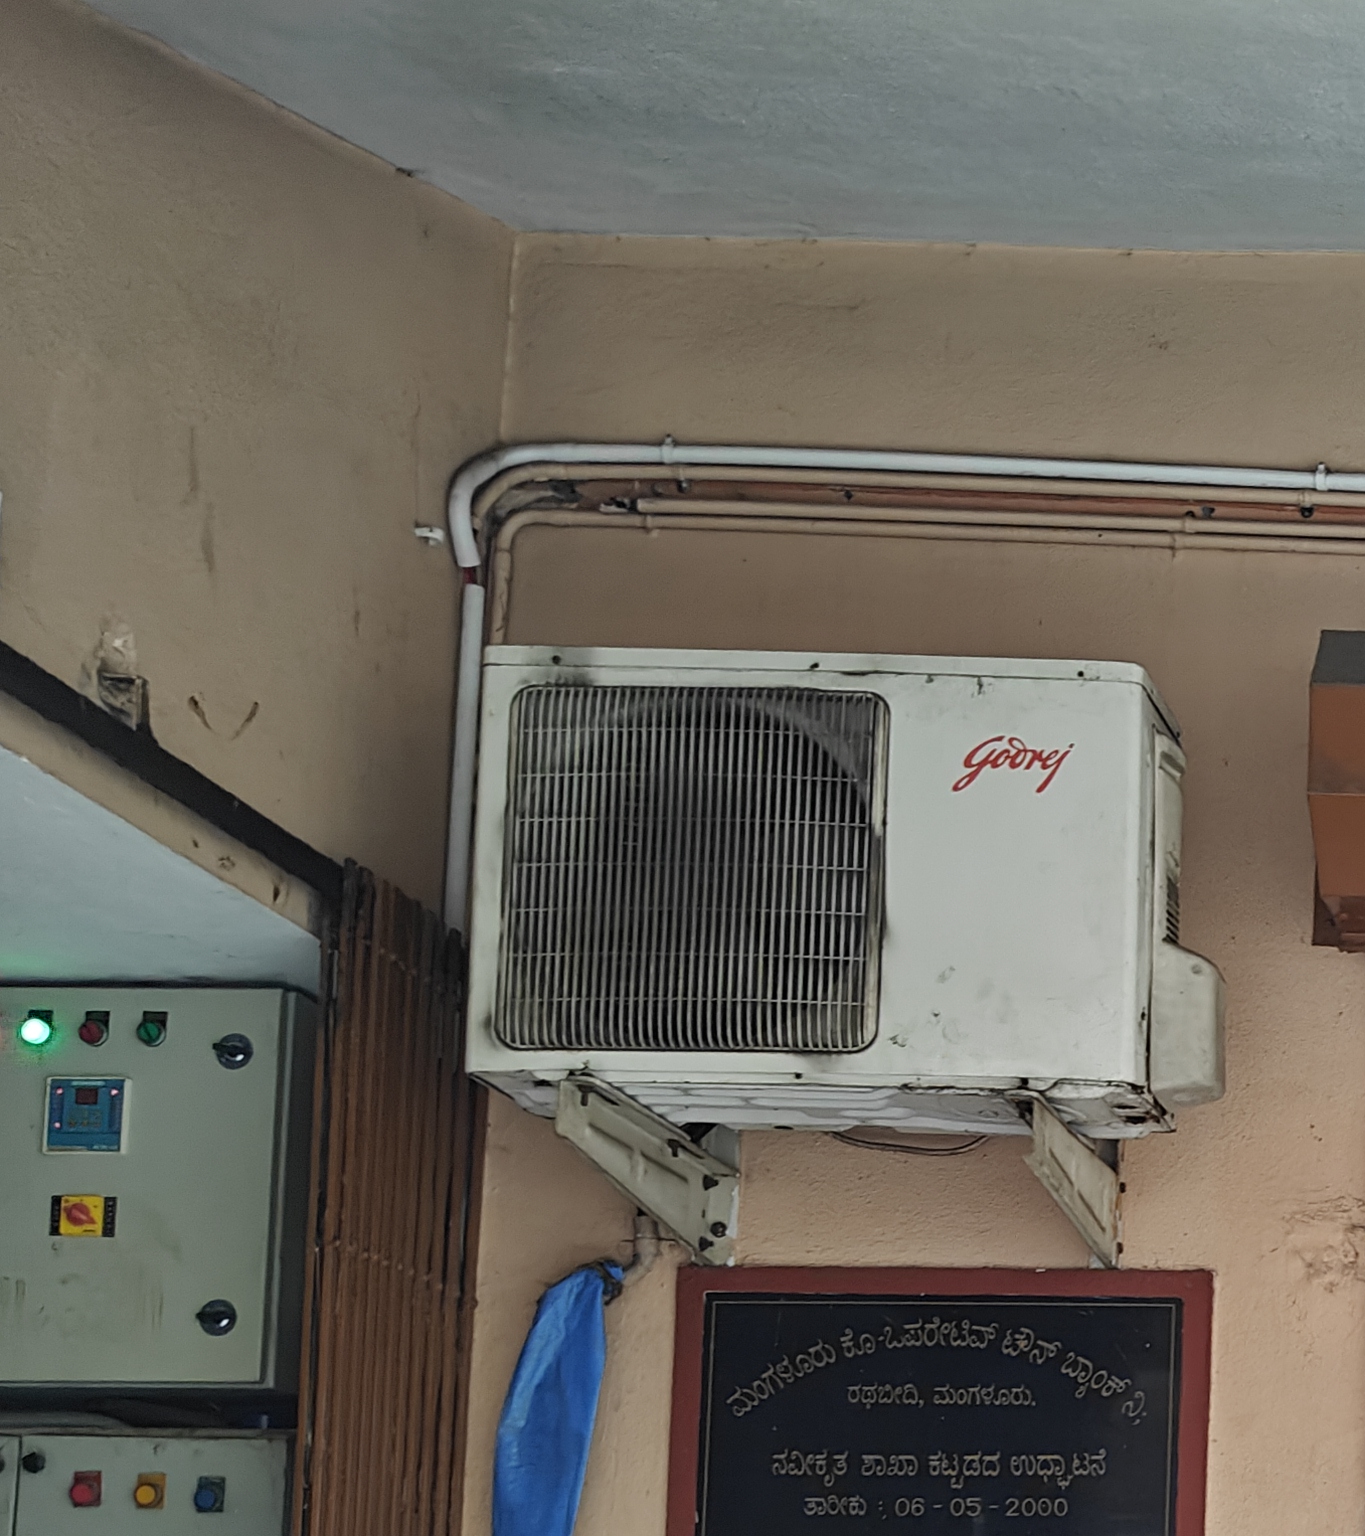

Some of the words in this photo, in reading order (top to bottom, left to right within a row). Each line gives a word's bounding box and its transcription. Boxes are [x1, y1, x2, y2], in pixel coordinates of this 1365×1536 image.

[952, 735, 1075, 793] Godrej
[726, 1339, 837, 1417] ಮಂಗಳೂರು
[1001, 1327, 1063, 1364] ಟೌನ್
[1060, 1352, 1131, 1399] ಬ್ಯಾಂಕ್
[933, 1383, 1037, 1407] ಮಂಗಳೂರು.
[771, 1450, 849, 1487] ನವೀಕೃತ
[860, 1452, 919, 1476] ಶಾಖಾ
[928, 1450, 1001, 1489] ಕಟ್ಟಡದ
[803, 1494, 867, 1517] ತಾರೀಕು
[894, 1496, 926, 1517] 06
[949, 1496, 982, 1517] 05
[1004, 1496, 1070, 1518] 2000
